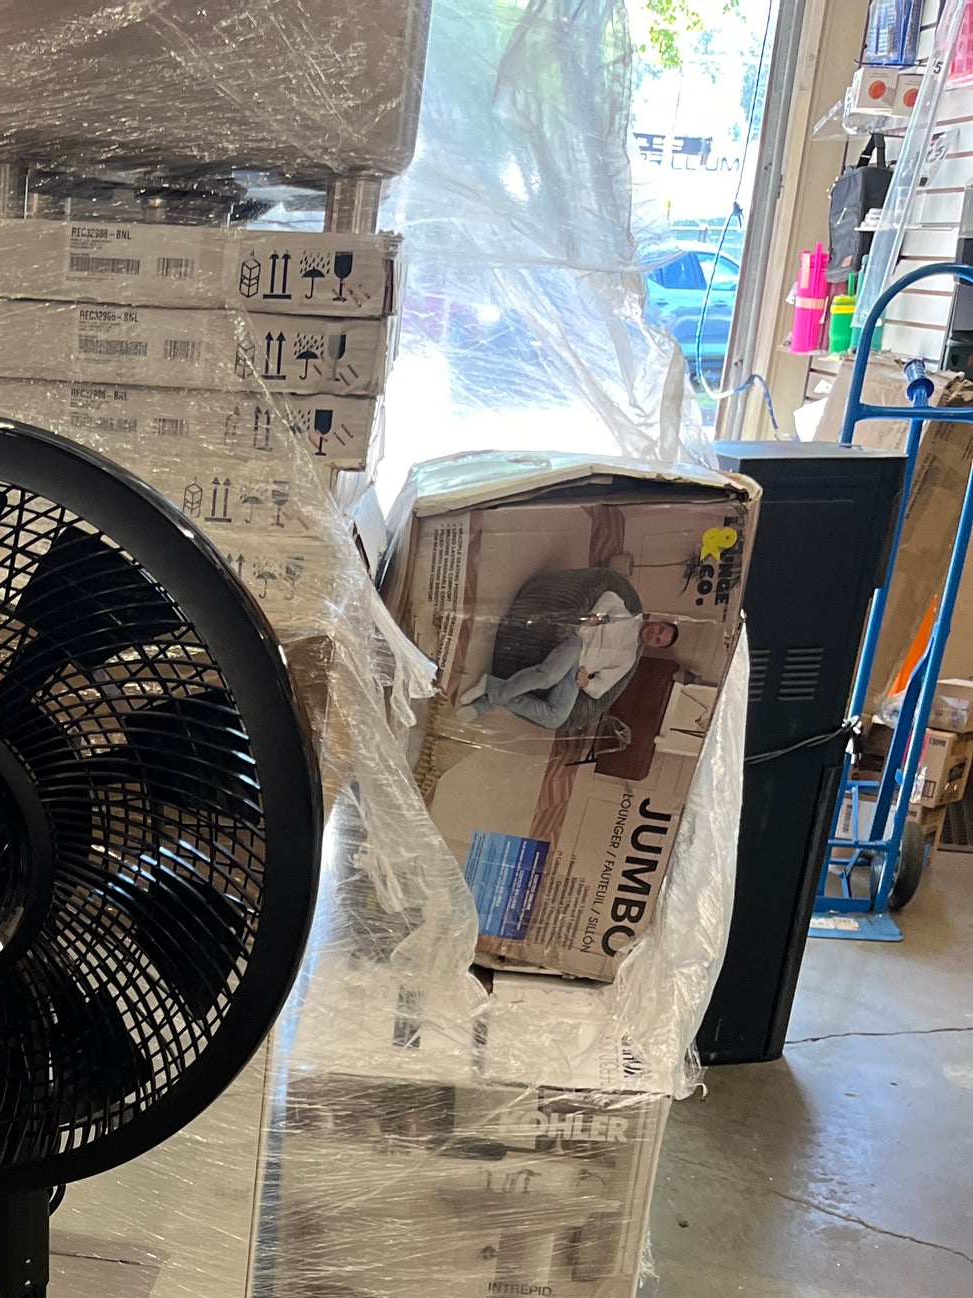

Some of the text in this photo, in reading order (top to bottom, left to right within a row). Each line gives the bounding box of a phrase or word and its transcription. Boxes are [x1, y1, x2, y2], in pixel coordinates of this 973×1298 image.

[609, 793, 634, 849] LOUNGER
[593, 859, 615, 907] FAUTEUIL
[601, 797, 672, 959] JUMBO
[579, 916, 598, 953] SILLÓN
[498, 1110, 629, 1143] KOHLER
[488, 1281, 553, 1296] INTREPID
